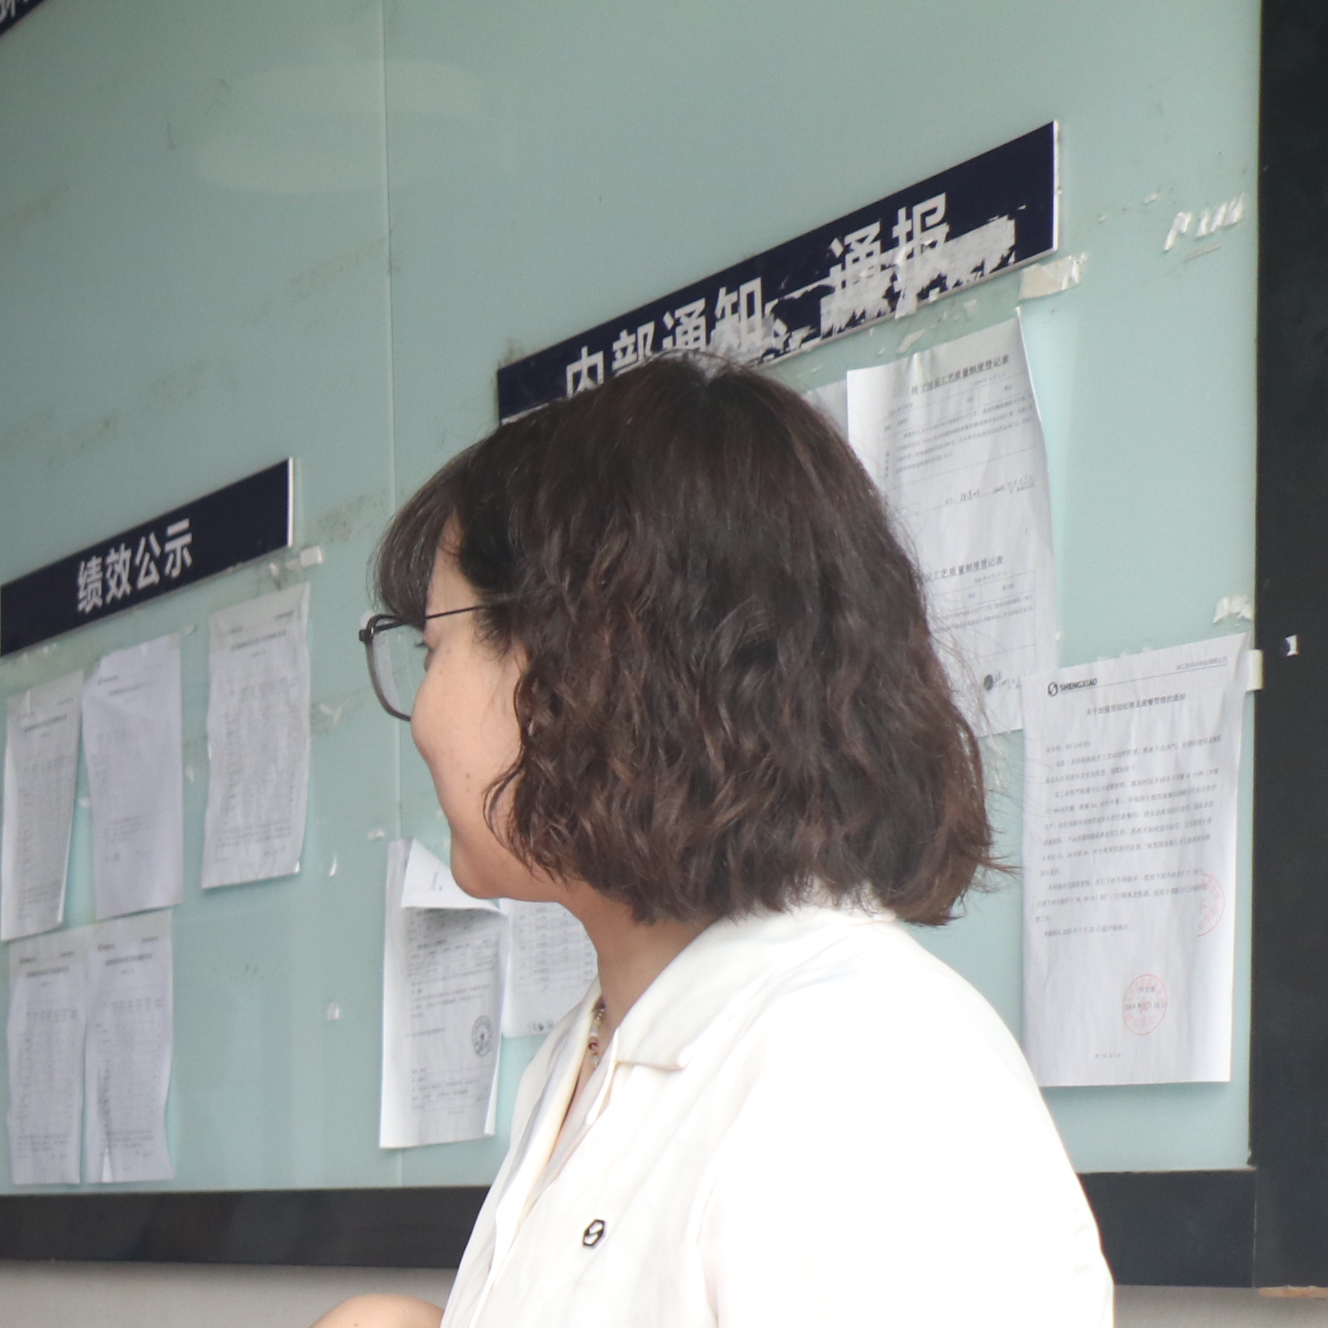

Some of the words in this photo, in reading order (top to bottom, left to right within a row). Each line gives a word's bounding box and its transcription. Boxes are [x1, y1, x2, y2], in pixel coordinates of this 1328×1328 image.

[77, 518, 193, 614] 绩效公示
[1059, 678, 1098, 693] SHENGXIAO
